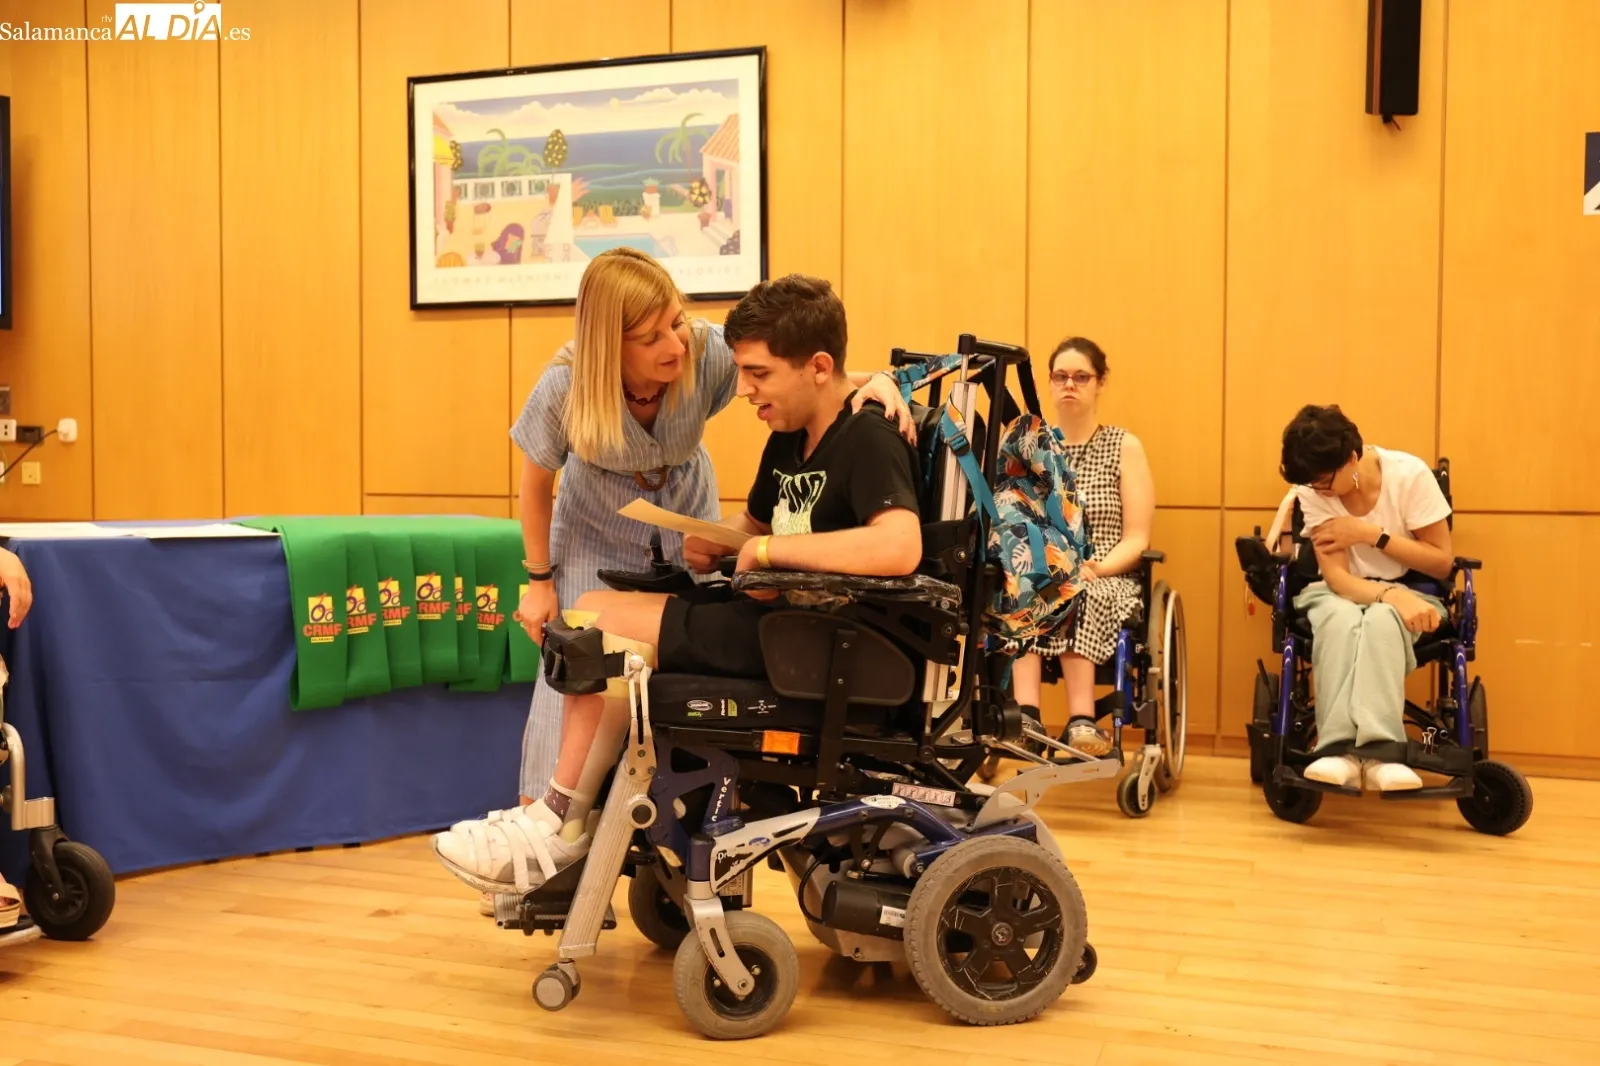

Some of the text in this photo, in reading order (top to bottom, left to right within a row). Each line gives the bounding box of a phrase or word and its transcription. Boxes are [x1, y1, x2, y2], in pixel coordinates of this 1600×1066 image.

[383, 606, 411, 620] RMF
[418, 601, 451, 614] RMF
[347, 613, 377, 627] RMF
[477, 612, 505, 625] RMF
[302, 623, 343, 637] CRMF
[711, 777, 731, 821] Vertic
